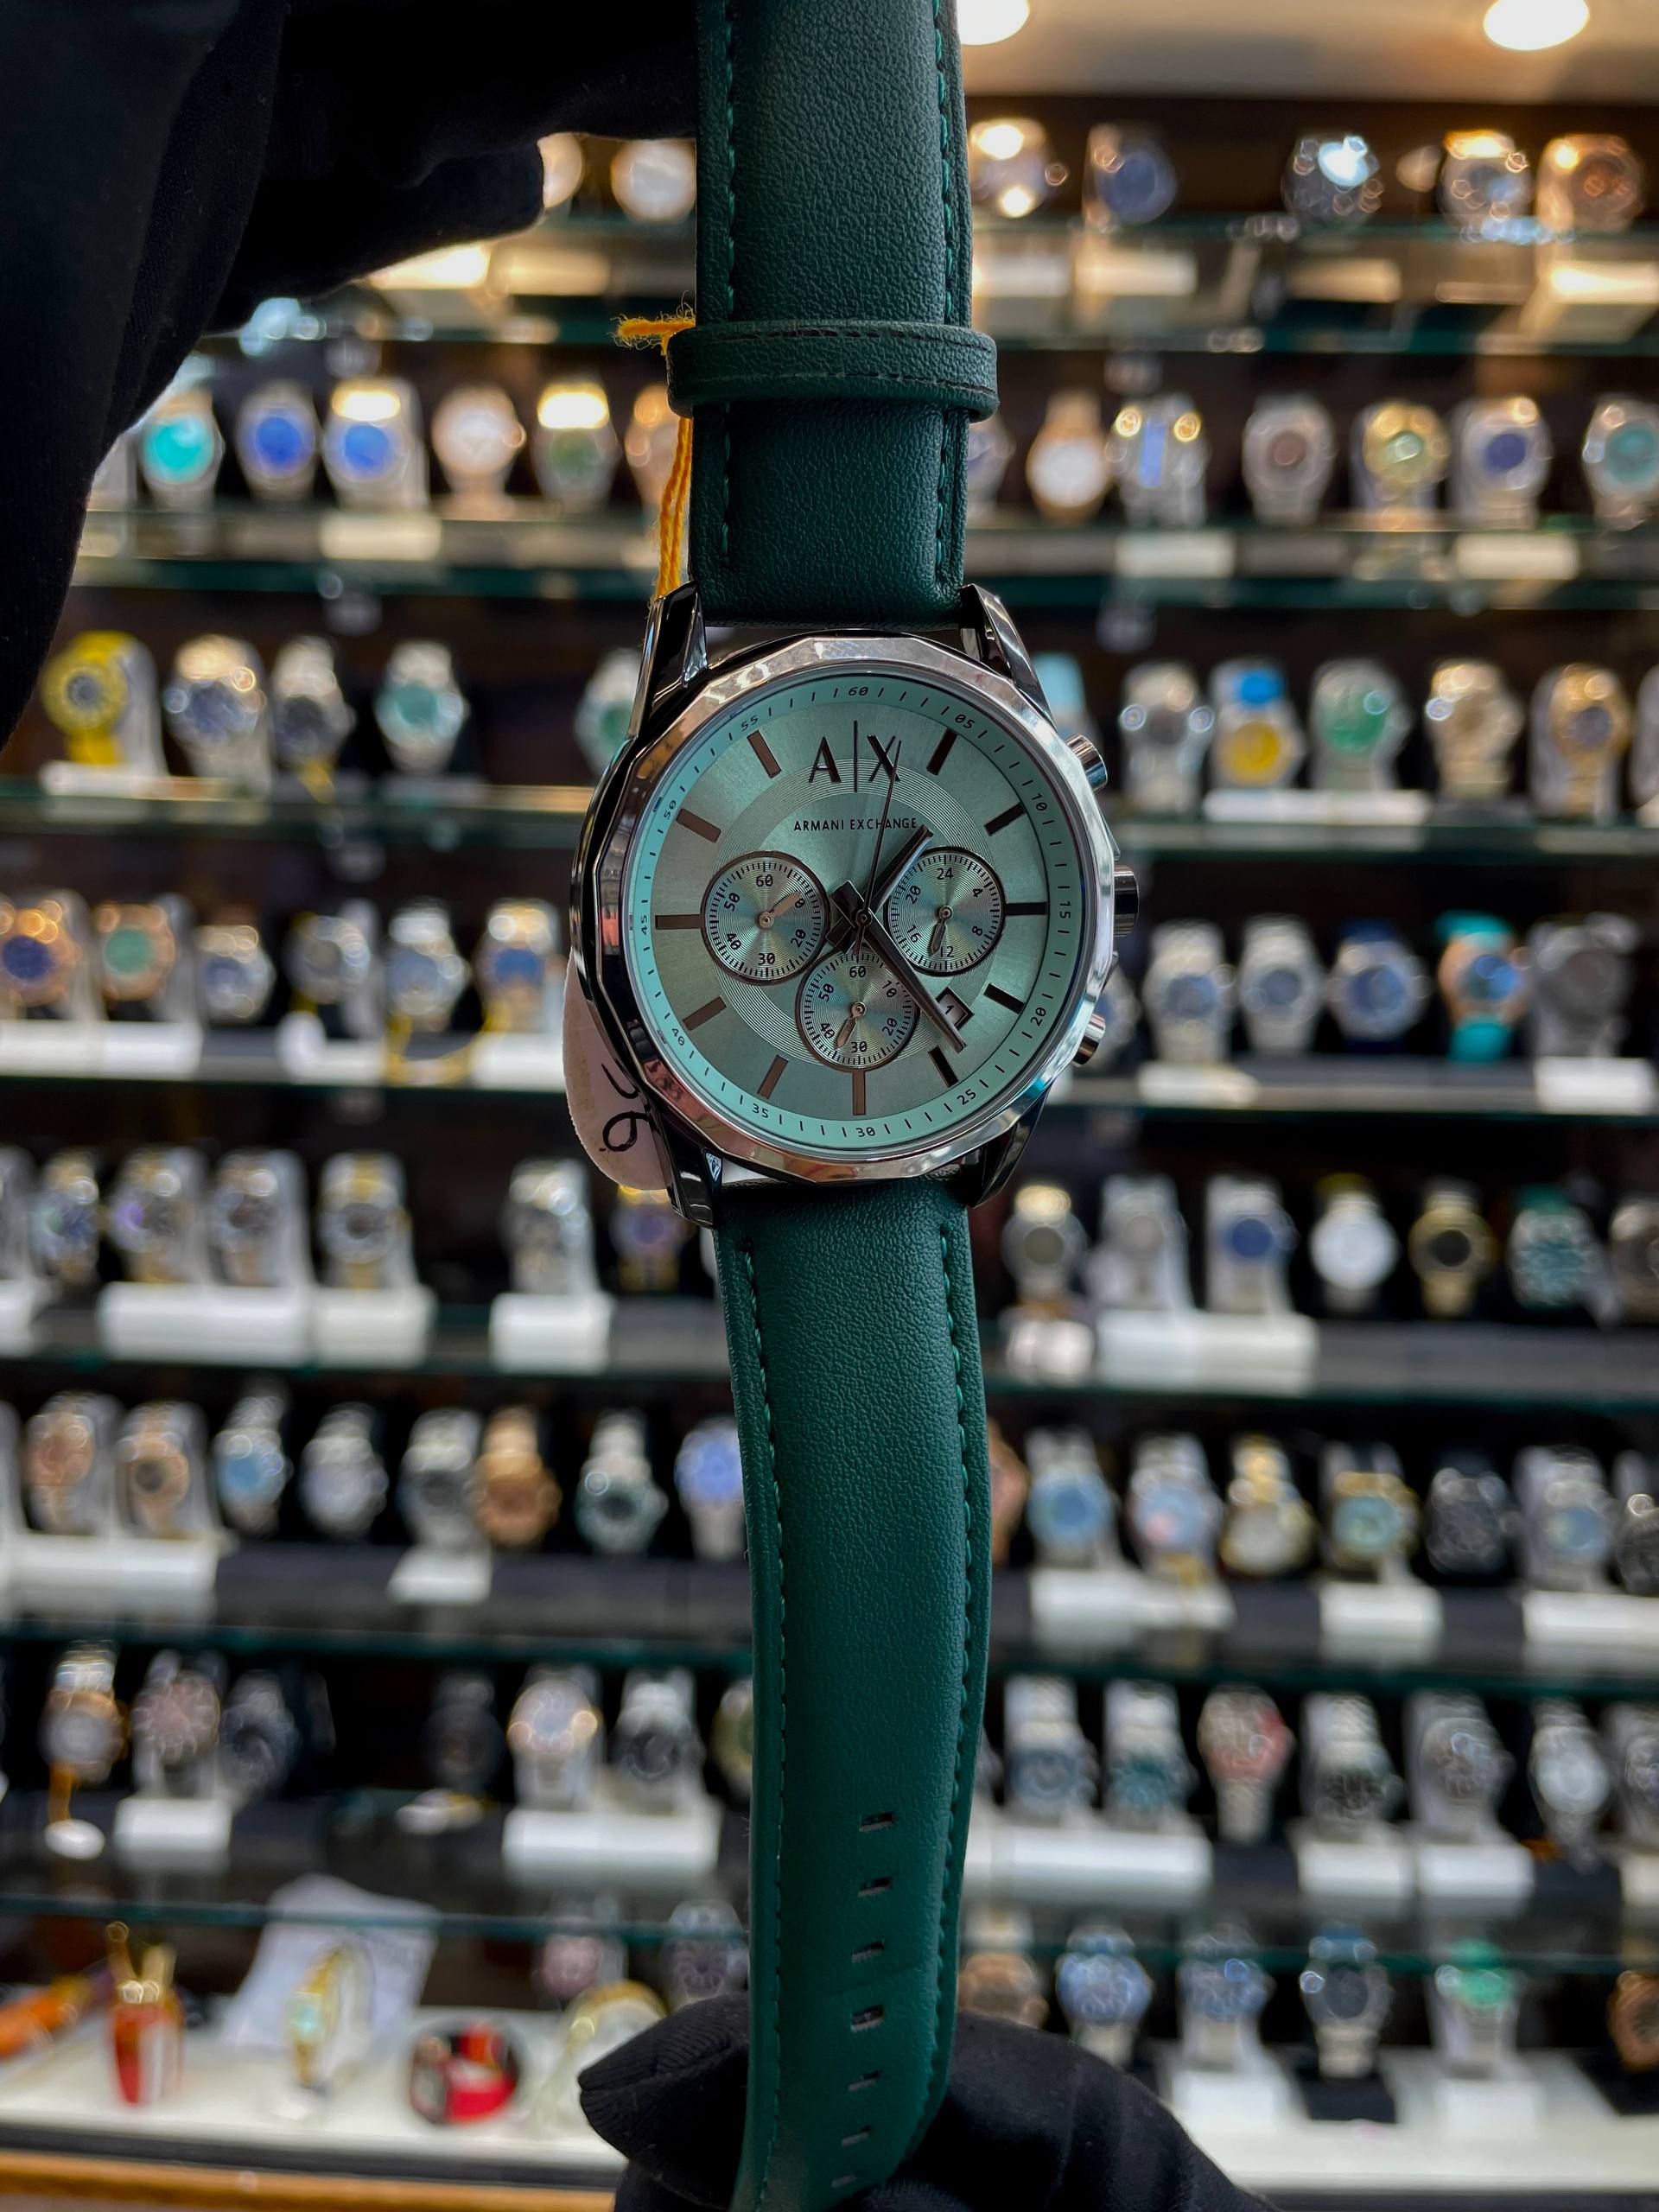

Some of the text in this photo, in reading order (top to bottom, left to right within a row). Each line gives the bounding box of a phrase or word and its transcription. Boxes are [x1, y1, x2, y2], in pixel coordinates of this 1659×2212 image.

[849, 687, 868, 696] 60
[741, 715, 759, 731] 55
[954, 714, 975, 729] 05
[664, 799, 677, 820] 50
[1031, 793, 1047, 811] 10
[793, 817, 917, 831] ARMANI EXCHANGE
[755, 874, 773, 887] 60
[937, 868, 953, 880] 24
[906, 885, 921, 904] 20
[973, 887, 983, 898] 4
[724, 892, 741, 912] 50
[1059, 901, 1071, 919] 15
[640, 914, 648, 935] 45
[971, 925, 983, 936] 8
[726, 932, 741, 950] 40
[791, 929, 806, 948] 20
[906, 925, 922, 944] 16
[758, 952, 775, 965] 30
[849, 966, 867, 978] 60
[818, 983, 834, 1002] 50
[882, 980, 897, 998] 10
[1030, 1007, 1046, 1027] 20
[820, 1022, 836, 1039] 40
[882, 1018, 898, 1036] 20
[671, 1027, 685, 1046] 40
[851, 1041, 868, 1052] 30
[957, 1089, 976, 1105] 25
[752, 1103, 769, 1118] 35
[857, 1127, 875, 1137] 30
